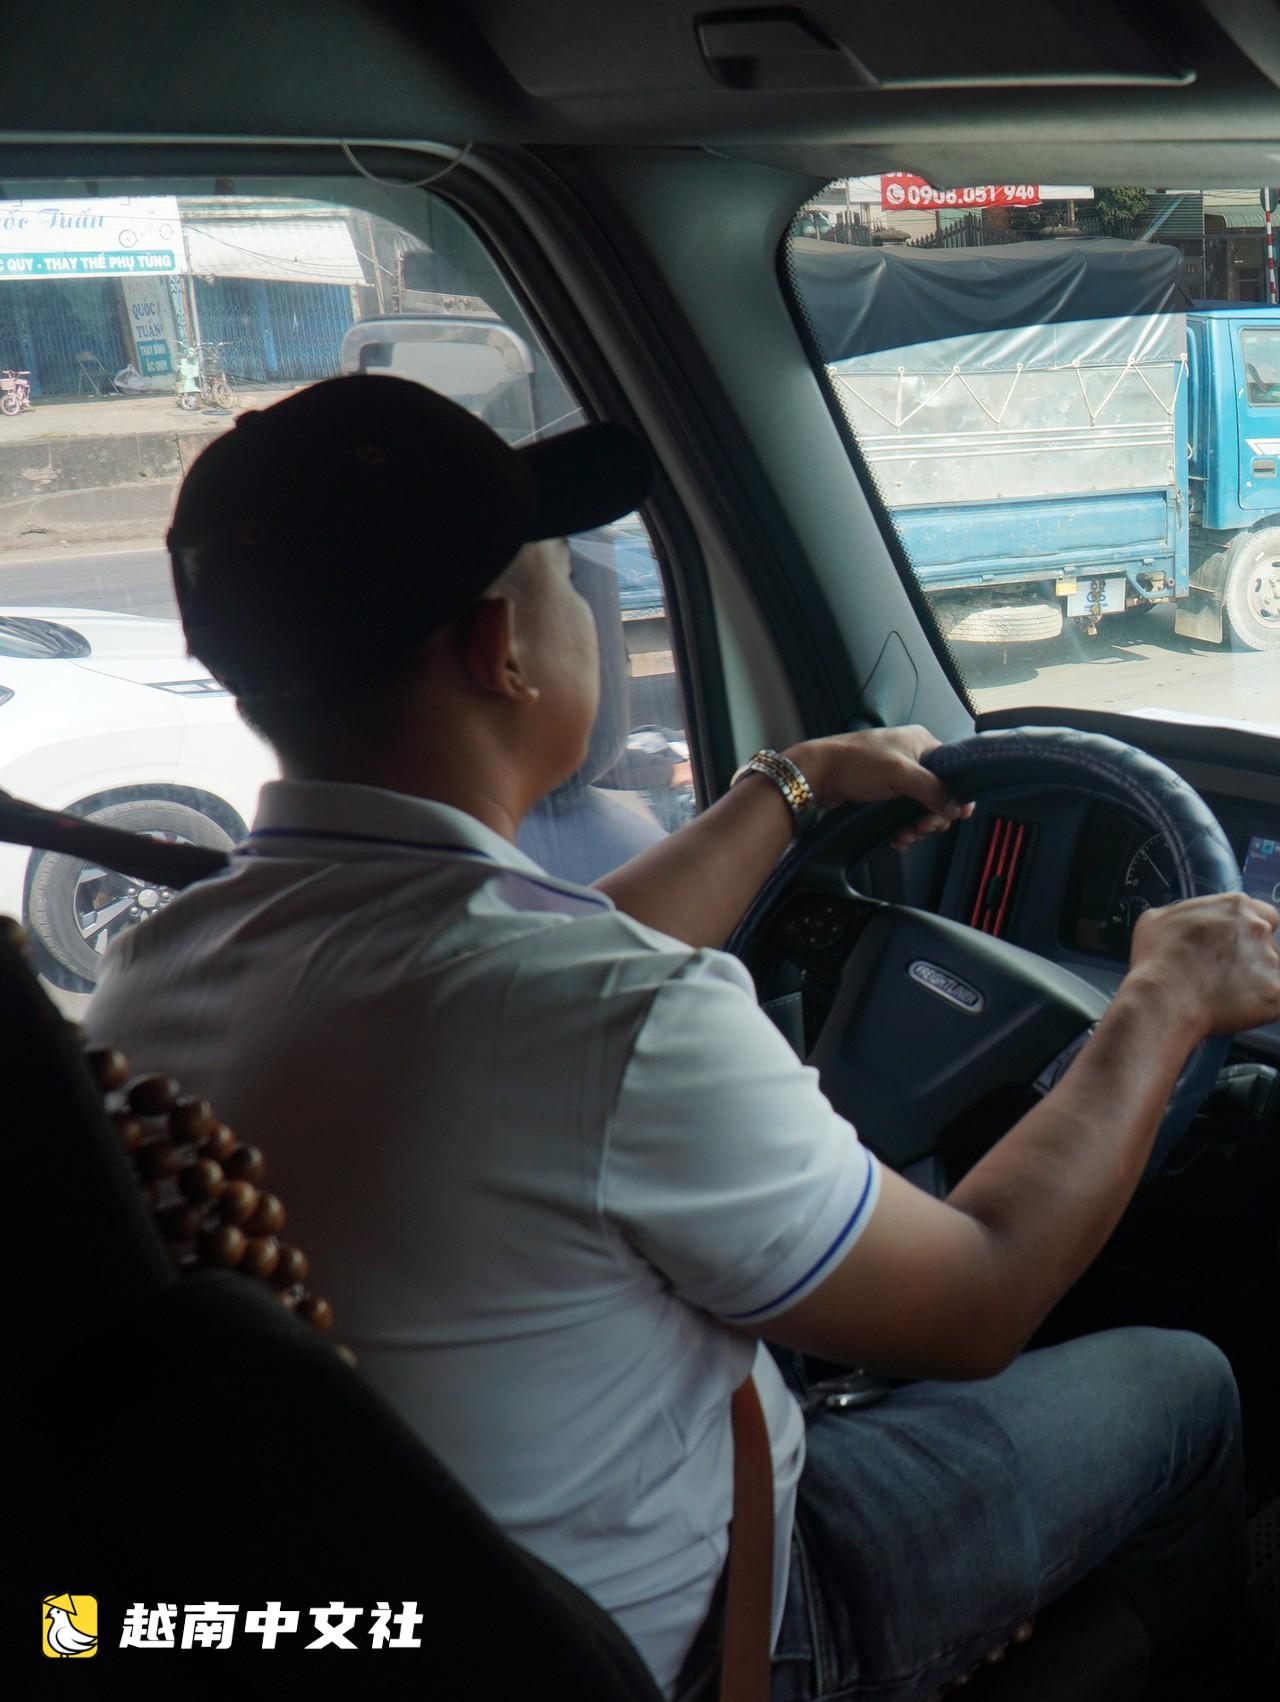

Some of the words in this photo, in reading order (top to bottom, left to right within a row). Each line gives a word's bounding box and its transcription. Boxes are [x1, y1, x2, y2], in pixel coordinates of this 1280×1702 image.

[0, 208, 29, 230] ốc
[39, 207, 104, 229] Tuấn
[7, 258, 34, 272] QUY
[44, 256, 78, 271] THAY
[109, 255, 134, 271] PHỤ
[137, 252, 172, 269] TÙNG
